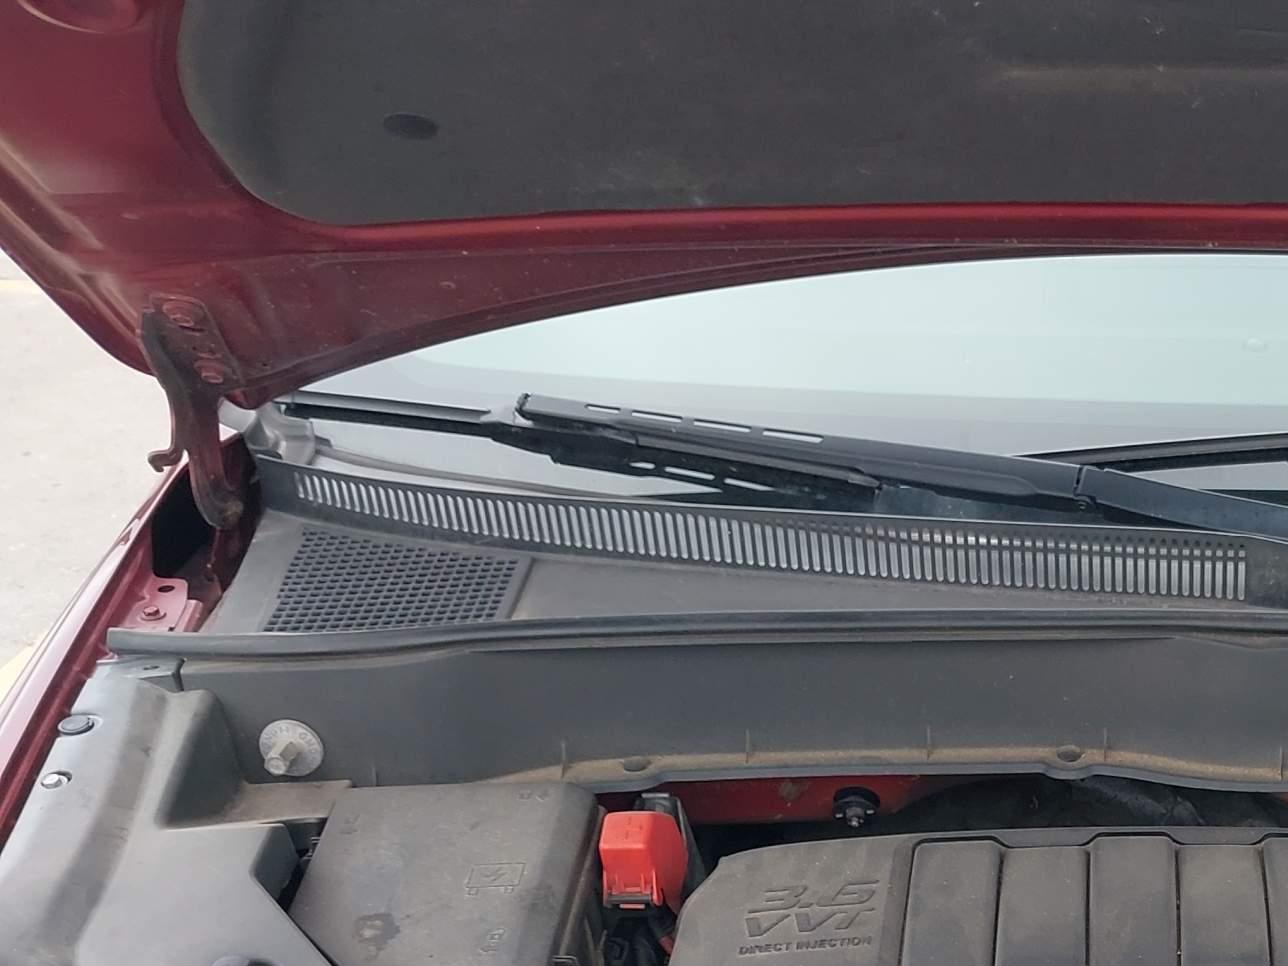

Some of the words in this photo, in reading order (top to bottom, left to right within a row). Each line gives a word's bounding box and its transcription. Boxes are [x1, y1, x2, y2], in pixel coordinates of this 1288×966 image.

[747, 879, 880, 914] 3.6
[744, 907, 876, 938] VVT
[738, 942, 793, 956] DIRECT
[795, 935, 873, 951] INJECTION
